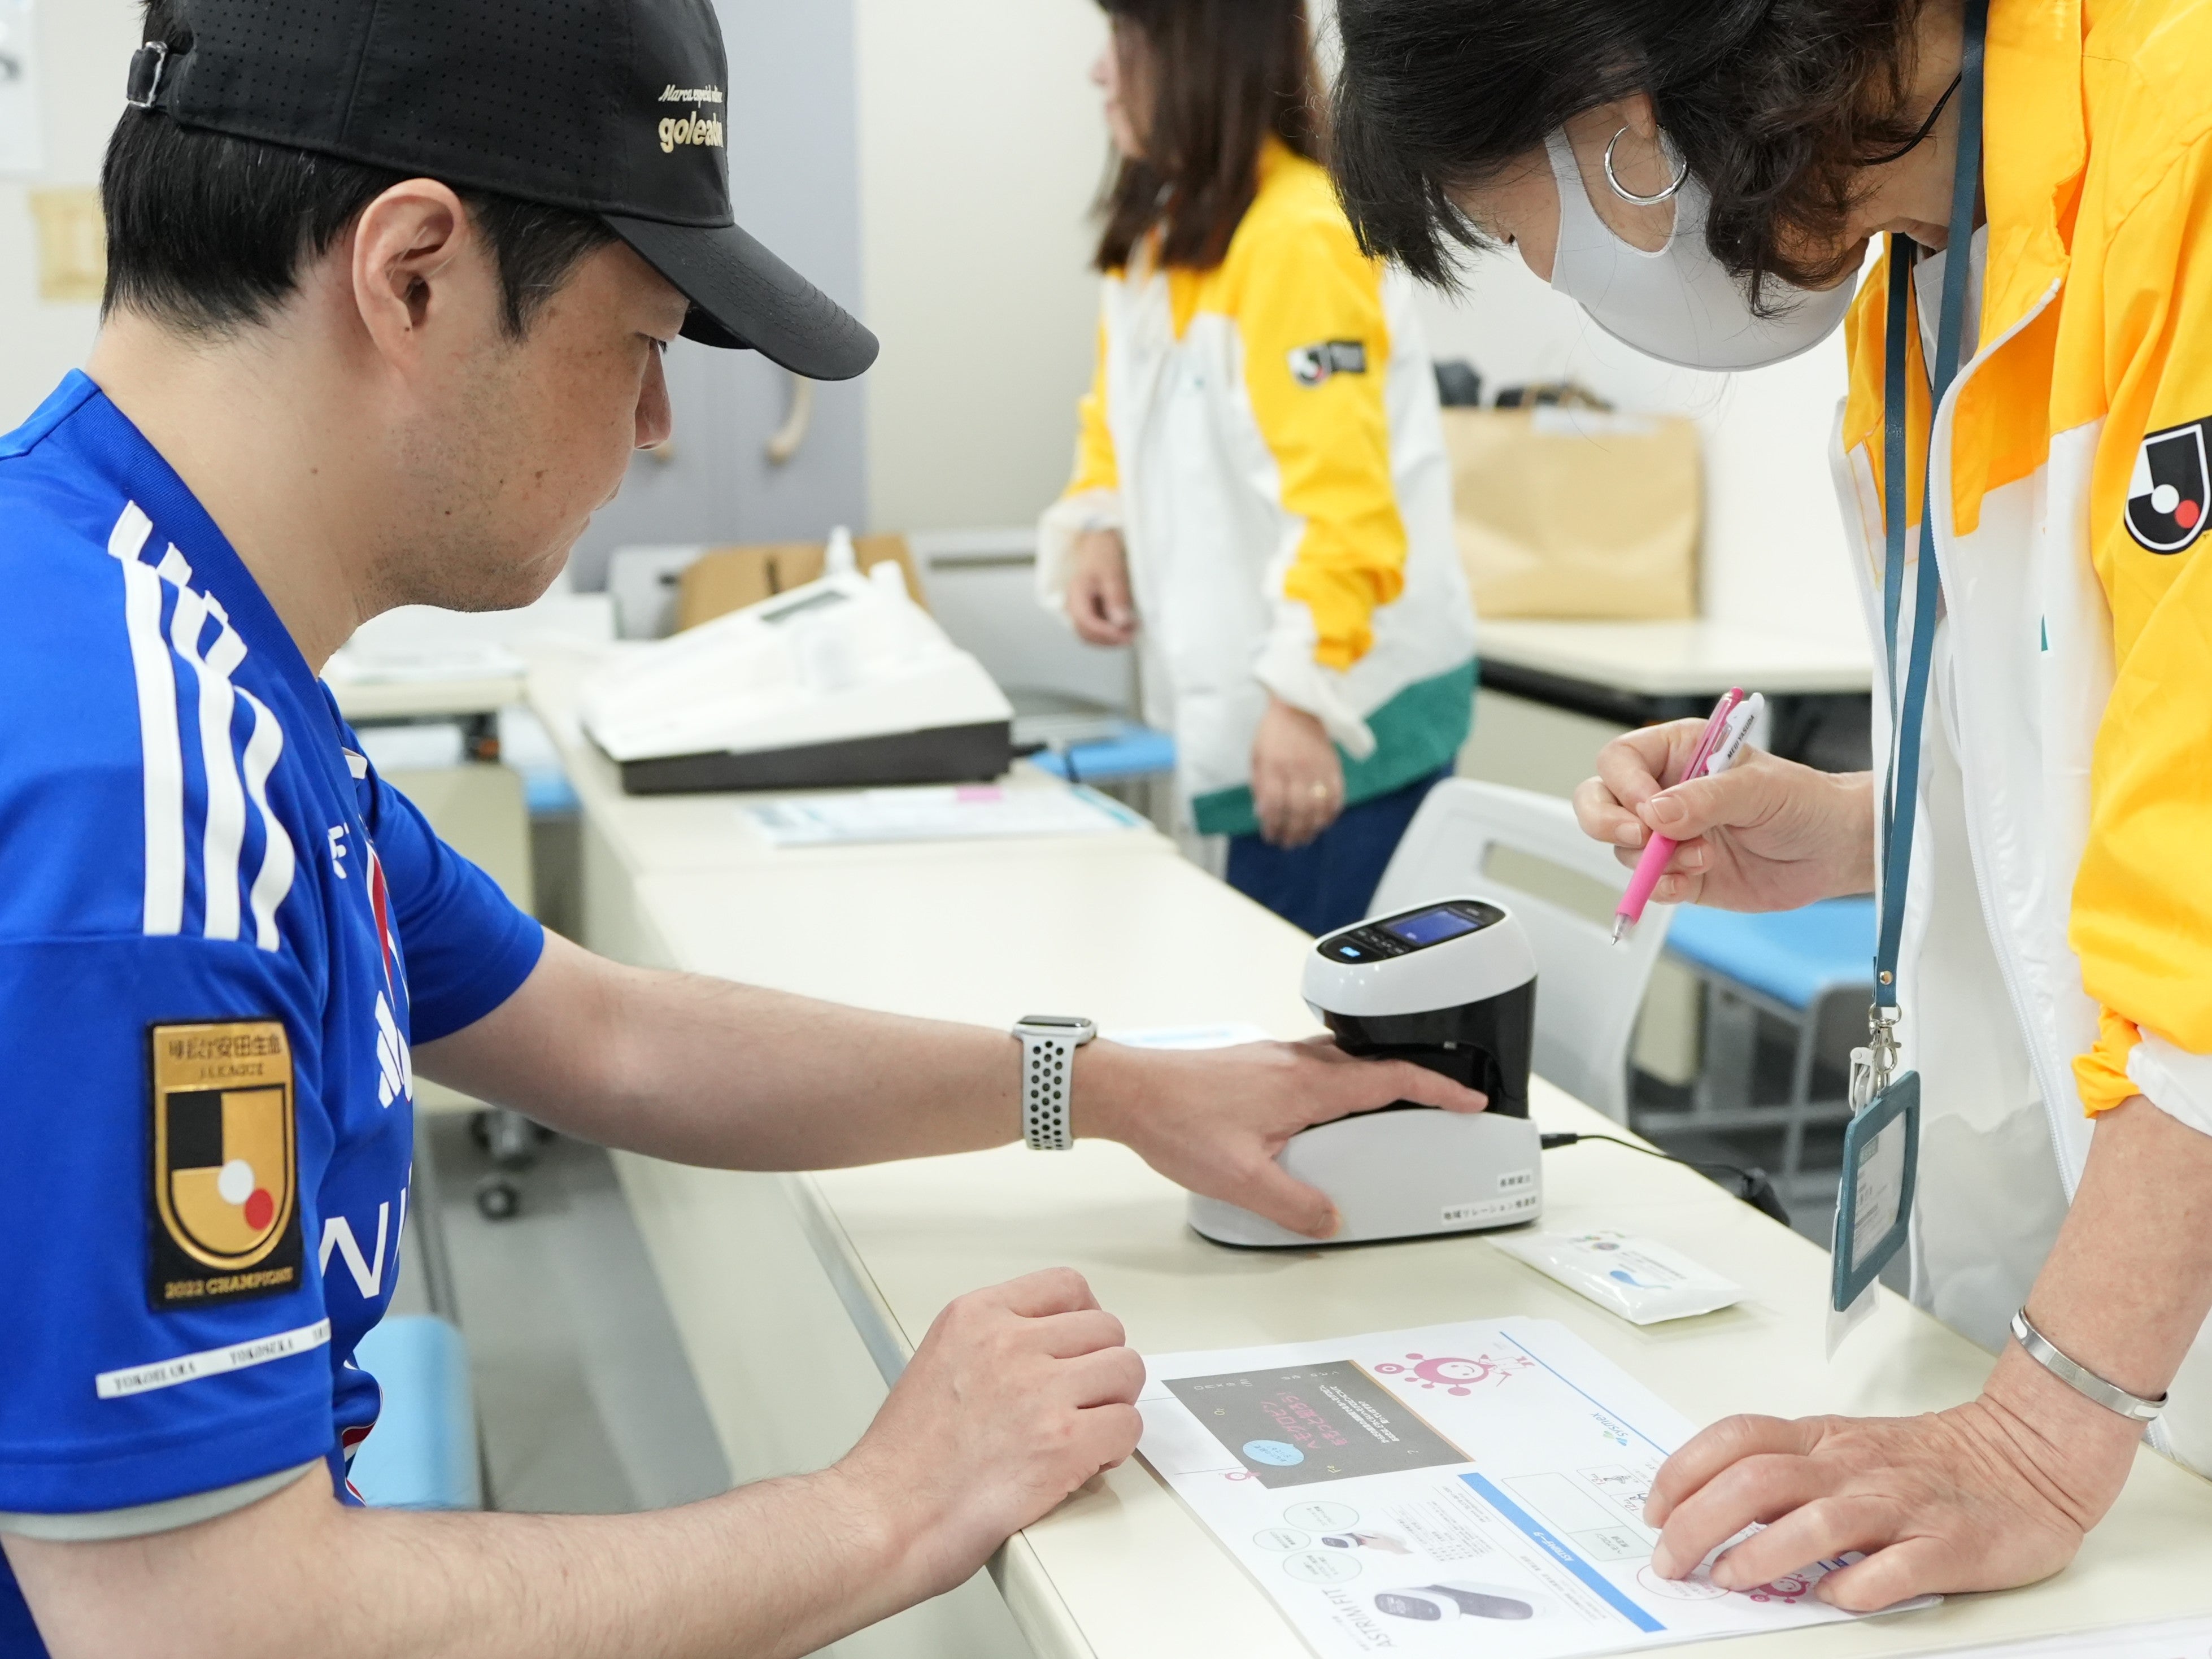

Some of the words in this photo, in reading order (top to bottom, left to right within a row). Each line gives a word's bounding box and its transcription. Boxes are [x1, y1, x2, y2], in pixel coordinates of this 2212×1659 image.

[1738, 715, 1754, 741] YASUDA
[1589, 1412, 1628, 1436] sysmex
[1321, 1588, 1353, 1605] FIT
[1339, 1605, 1397, 1647] ASTRIM
